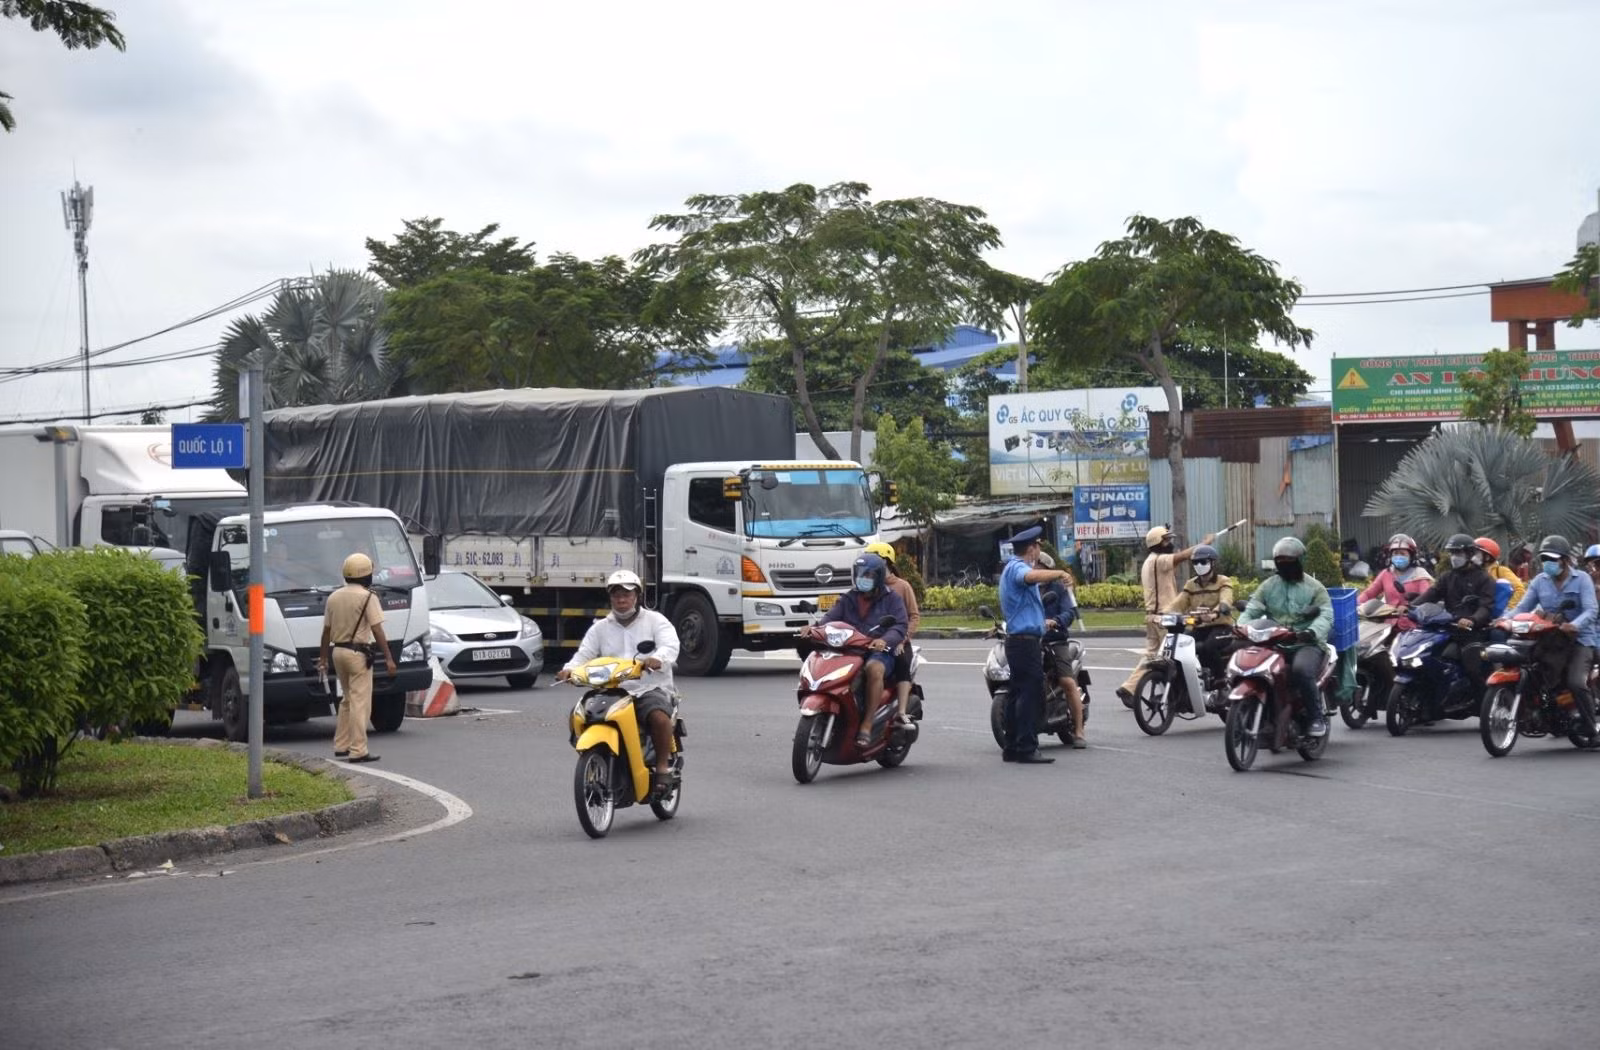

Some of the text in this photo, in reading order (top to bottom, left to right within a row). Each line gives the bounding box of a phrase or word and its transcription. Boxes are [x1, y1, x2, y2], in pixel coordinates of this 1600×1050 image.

[1386, 371, 1433, 386] AN
[179, 435, 232, 456] QUỐC LỘ 1
[1091, 491, 1145, 503] PINACO
